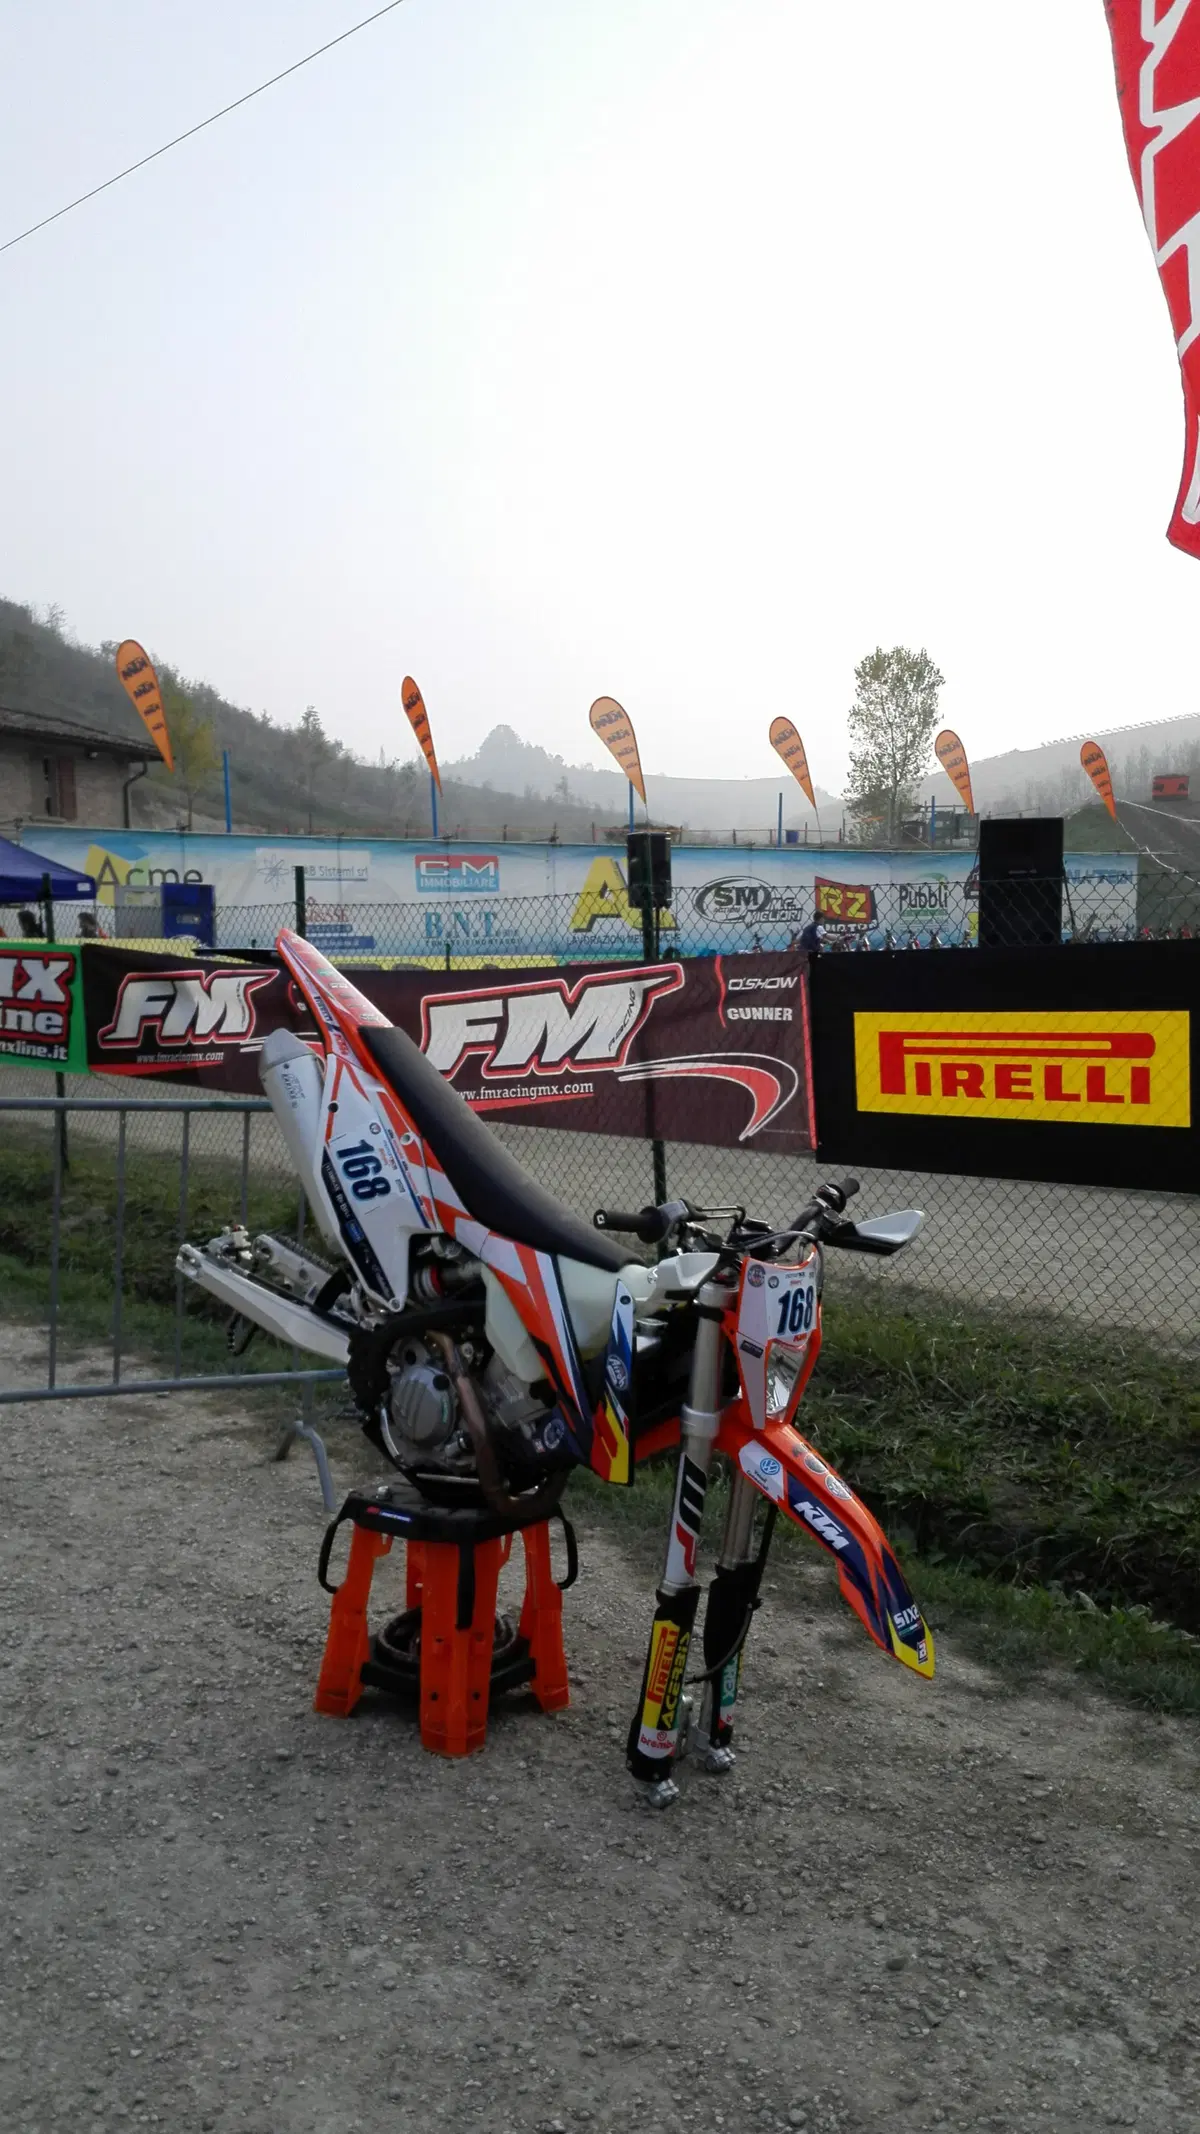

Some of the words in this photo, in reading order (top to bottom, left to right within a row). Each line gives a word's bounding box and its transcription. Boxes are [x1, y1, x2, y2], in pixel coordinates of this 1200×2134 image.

[94, 854, 204, 888] Acme
[420, 877, 497, 888] IMMOBILIARE
[714, 886, 758, 906] SM
[819, 886, 867, 919] RZ
[102, 974, 272, 1041] FM
[424, 975, 674, 1072] FM
[727, 1007, 793, 1021] GUNNER
[136, 1051, 224, 1064] www.fmracingmx.com
[878, 1031, 1156, 1106] PIRELLI
[336, 1139, 391, 1201] 168
[777, 1285, 814, 1335] 168
[794, 1501, 850, 1550] KTM
[647, 1626, 679, 1704] PIRELLI
